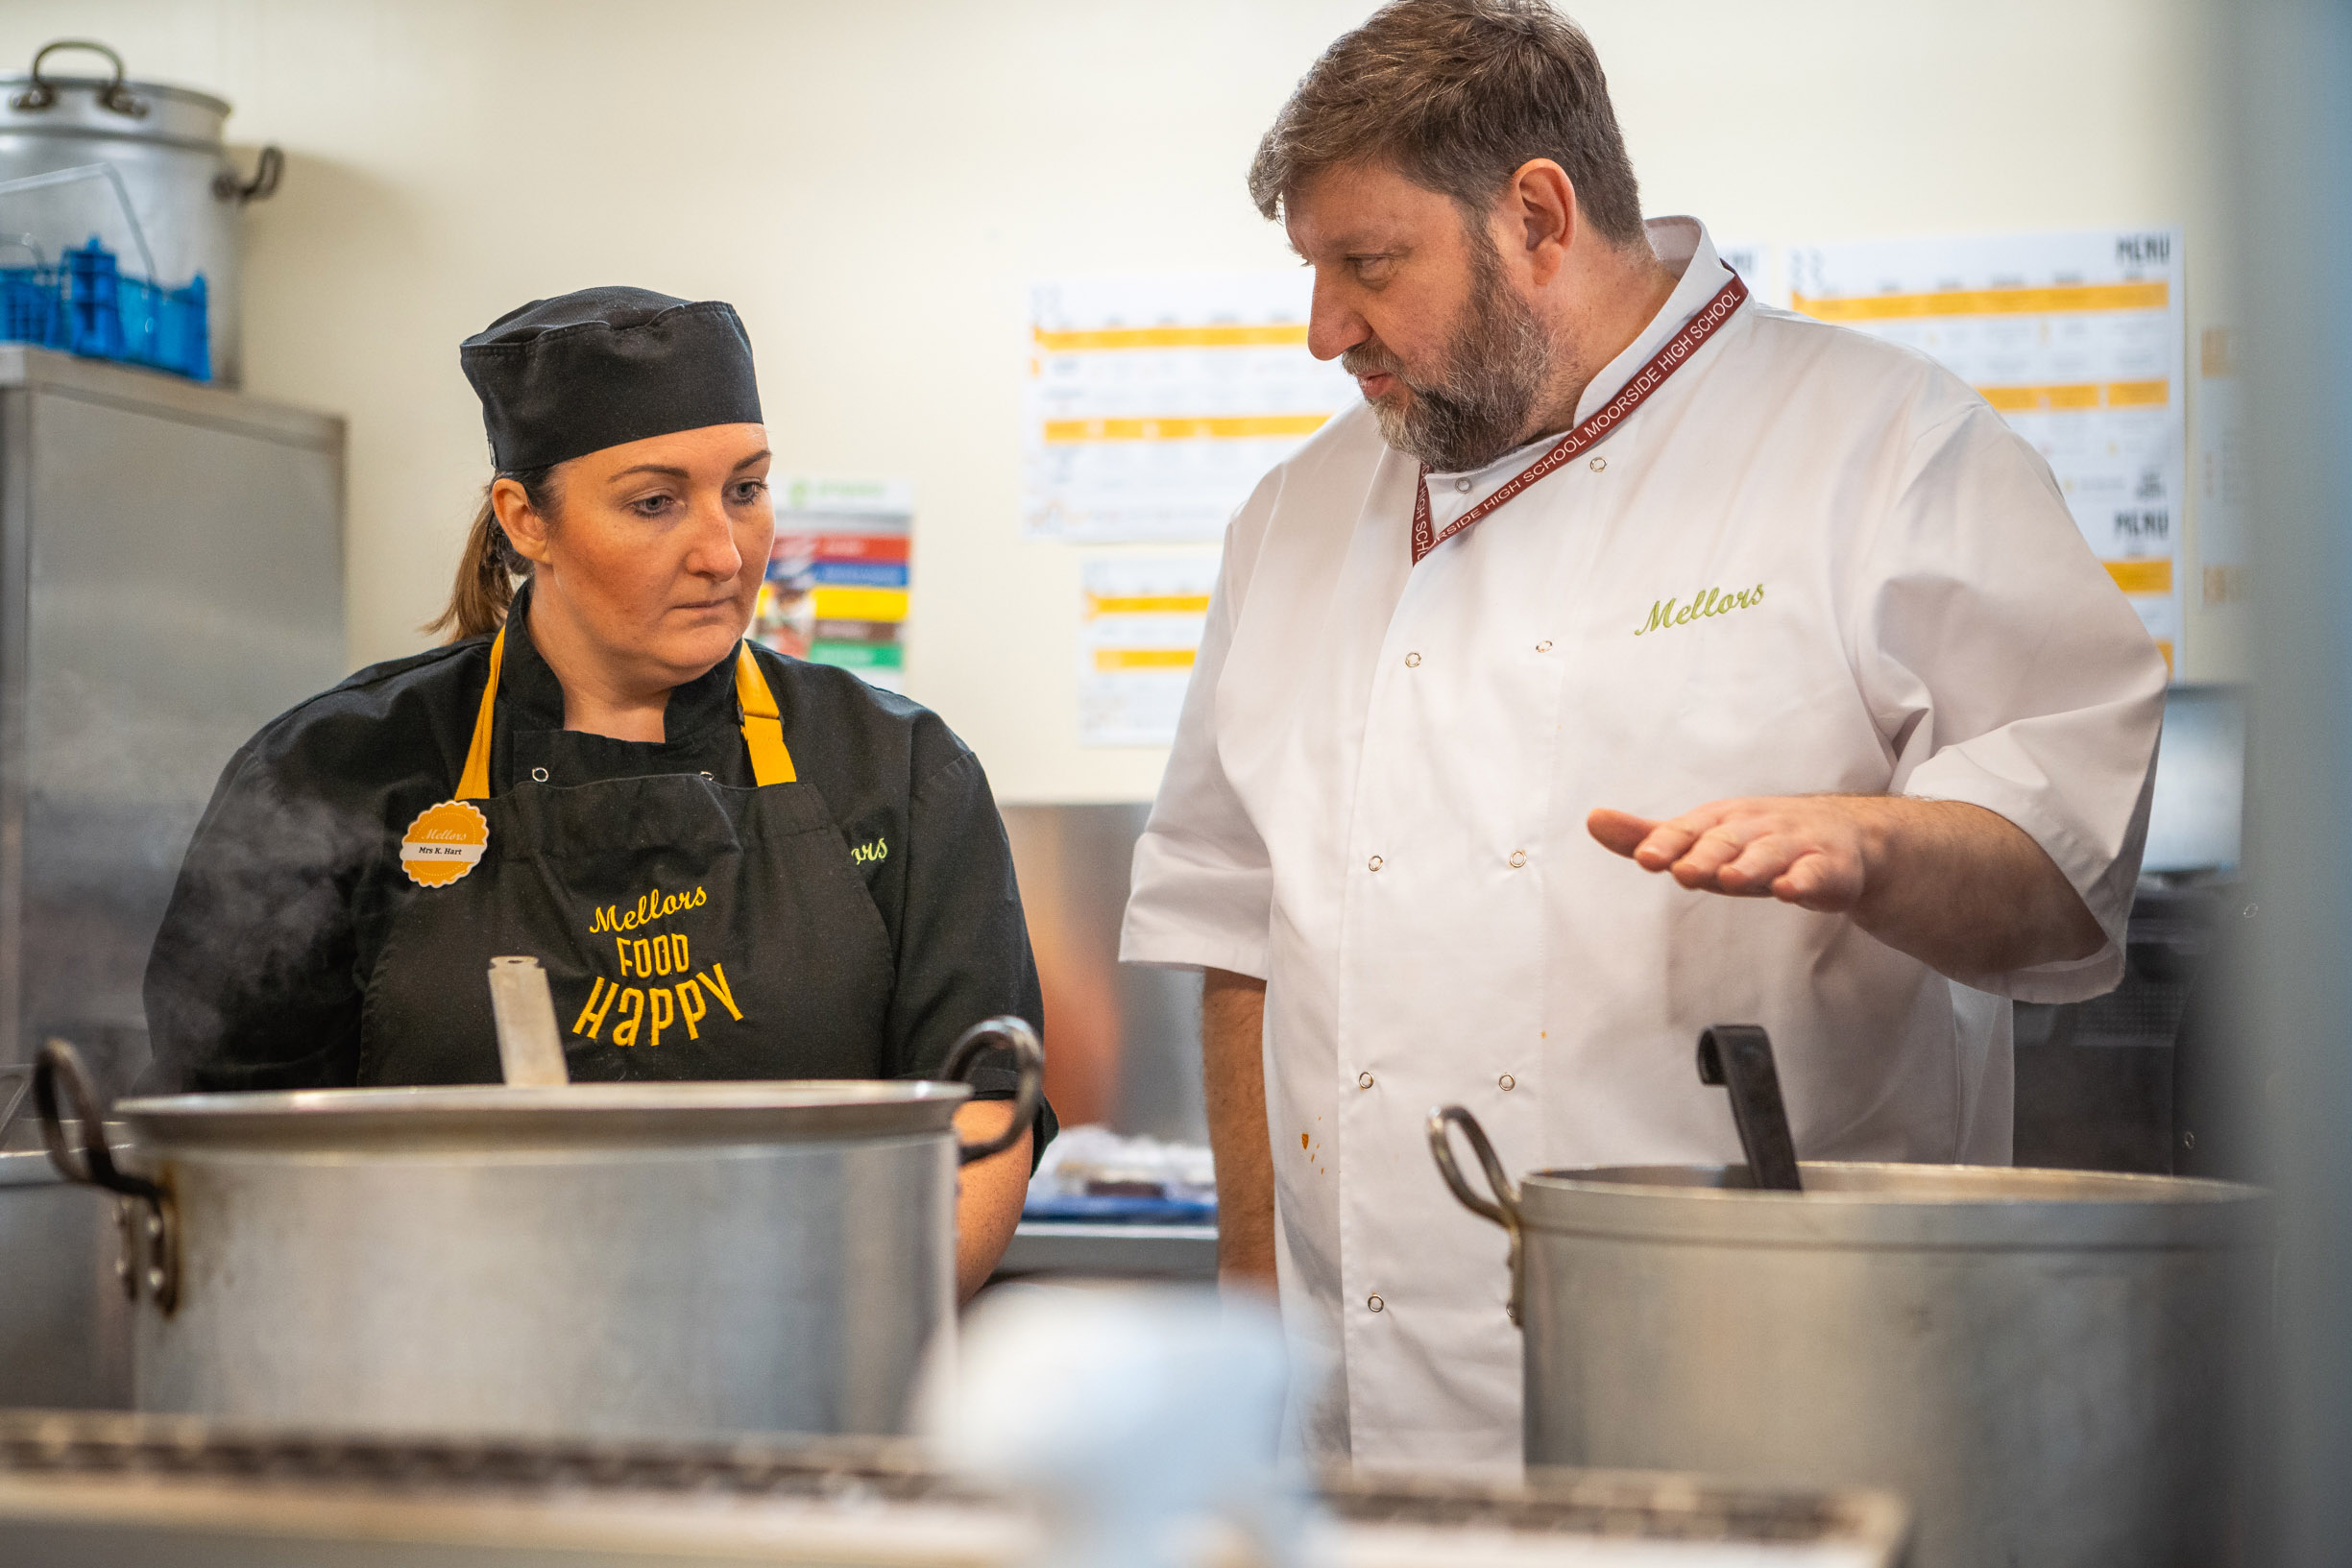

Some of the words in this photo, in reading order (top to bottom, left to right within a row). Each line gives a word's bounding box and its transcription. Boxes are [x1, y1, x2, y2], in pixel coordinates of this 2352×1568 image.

[1483, 480, 1521, 510] HIGH
[1522, 436, 1587, 482] SCHOOL
[1584, 367, 1661, 438] MOORSIDE
[1658, 334, 1694, 371] HIGH
[1690, 290, 1740, 339] SCHOOL
[1416, 486, 1428, 520] HIGH
[1634, 583, 1764, 636] Mellors
[419, 846, 433, 855] Mrs
[421, 829, 467, 841] Mellors
[589, 885, 707, 933] Mellors
[616, 932, 690, 978] FOOD
